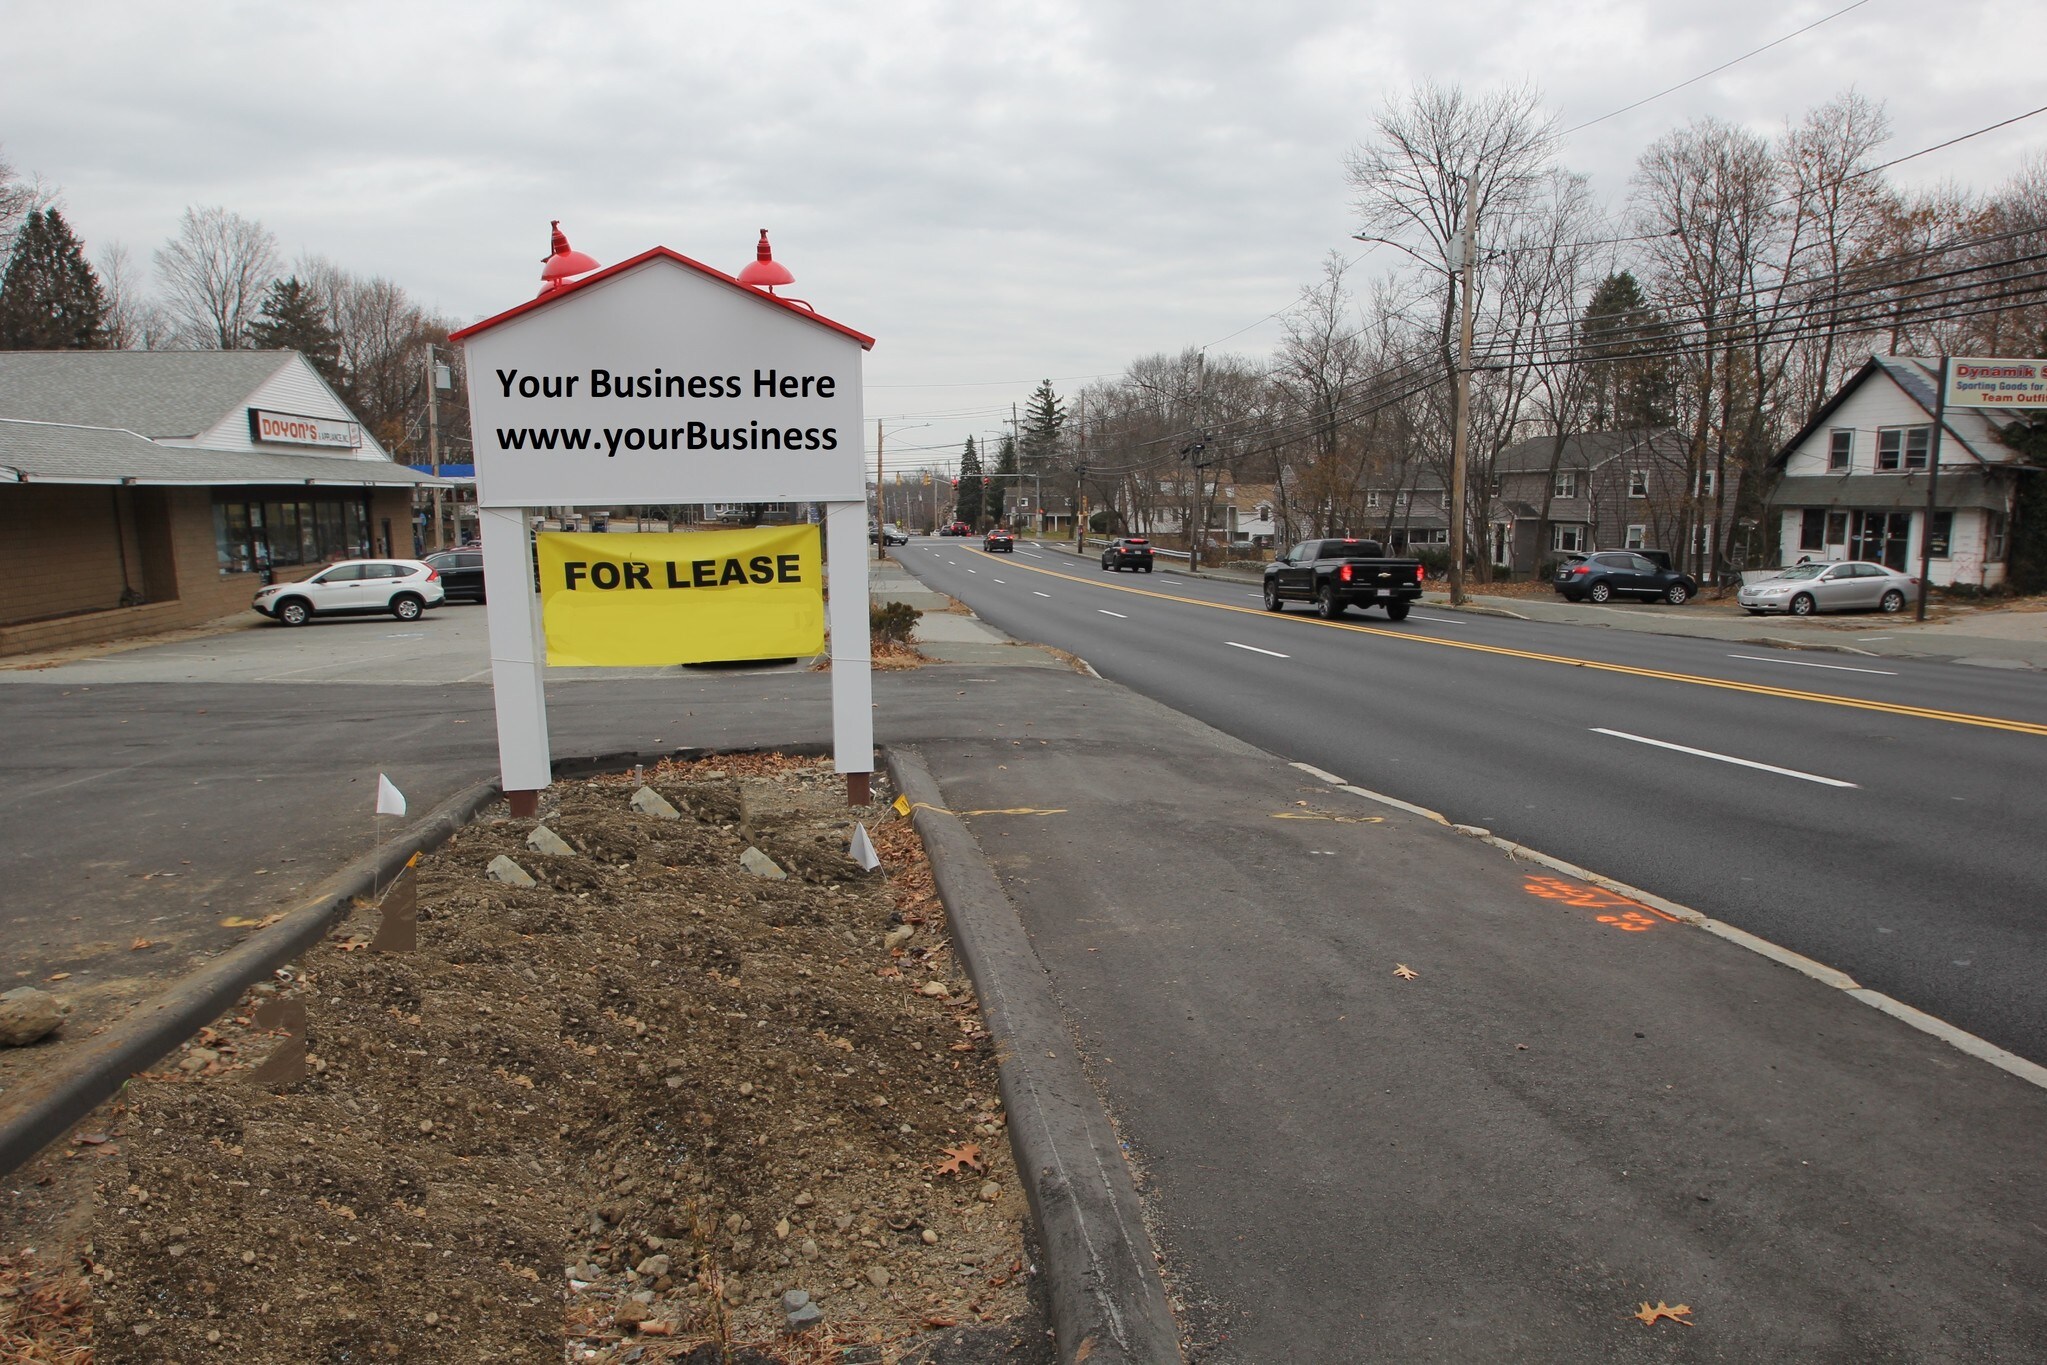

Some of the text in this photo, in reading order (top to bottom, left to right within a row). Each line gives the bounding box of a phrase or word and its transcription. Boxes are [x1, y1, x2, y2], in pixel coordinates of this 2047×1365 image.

[496, 368, 835, 398] Your Business Here
[1956, 364, 2036, 380] Dynamik
[1956, 381, 2044, 391] Sporting Goods for
[1981, 393, 2047, 403] Team Outfi
[262, 418, 317, 441] DOYON'S
[496, 420, 838, 457] www.yourBusiness
[564, 554, 802, 591] FOR LEASE
